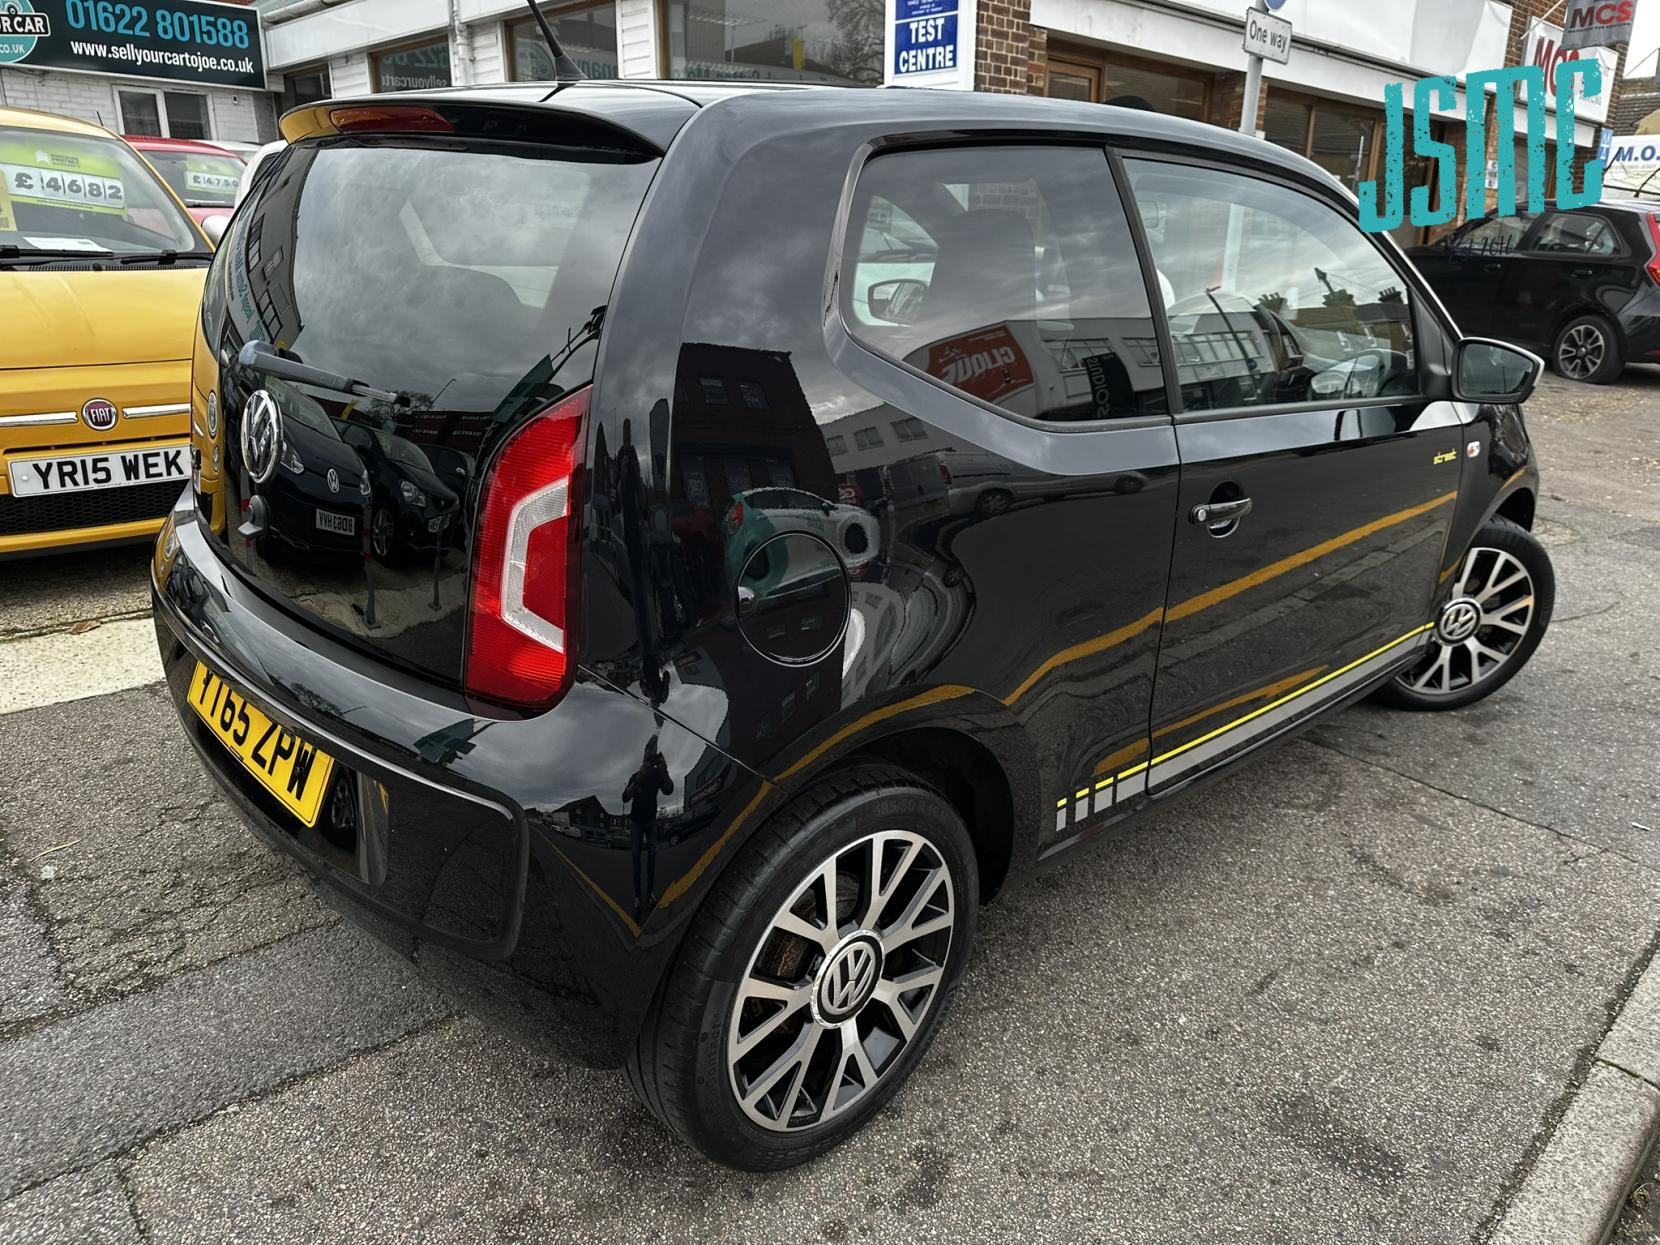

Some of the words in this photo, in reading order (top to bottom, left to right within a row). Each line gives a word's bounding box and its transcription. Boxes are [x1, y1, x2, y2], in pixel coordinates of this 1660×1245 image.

[14, 16, 46, 33] CAR
[65, 0, 150, 38] 01622
[156, 9, 249, 49] 801588
[1570, 1, 1633, 29] MCS
[909, 18, 945, 44] TEST
[1250, 20, 1268, 44] One
[1270, 32, 1288, 54] way
[71, 40, 254, 74] www.sellyourcartojoe.co.uk
[899, 45, 954, 73] CENTRE
[90, 407, 111, 423] FIAT
[33, 460, 112, 490] YR15
[121, 449, 185, 480] WEK
